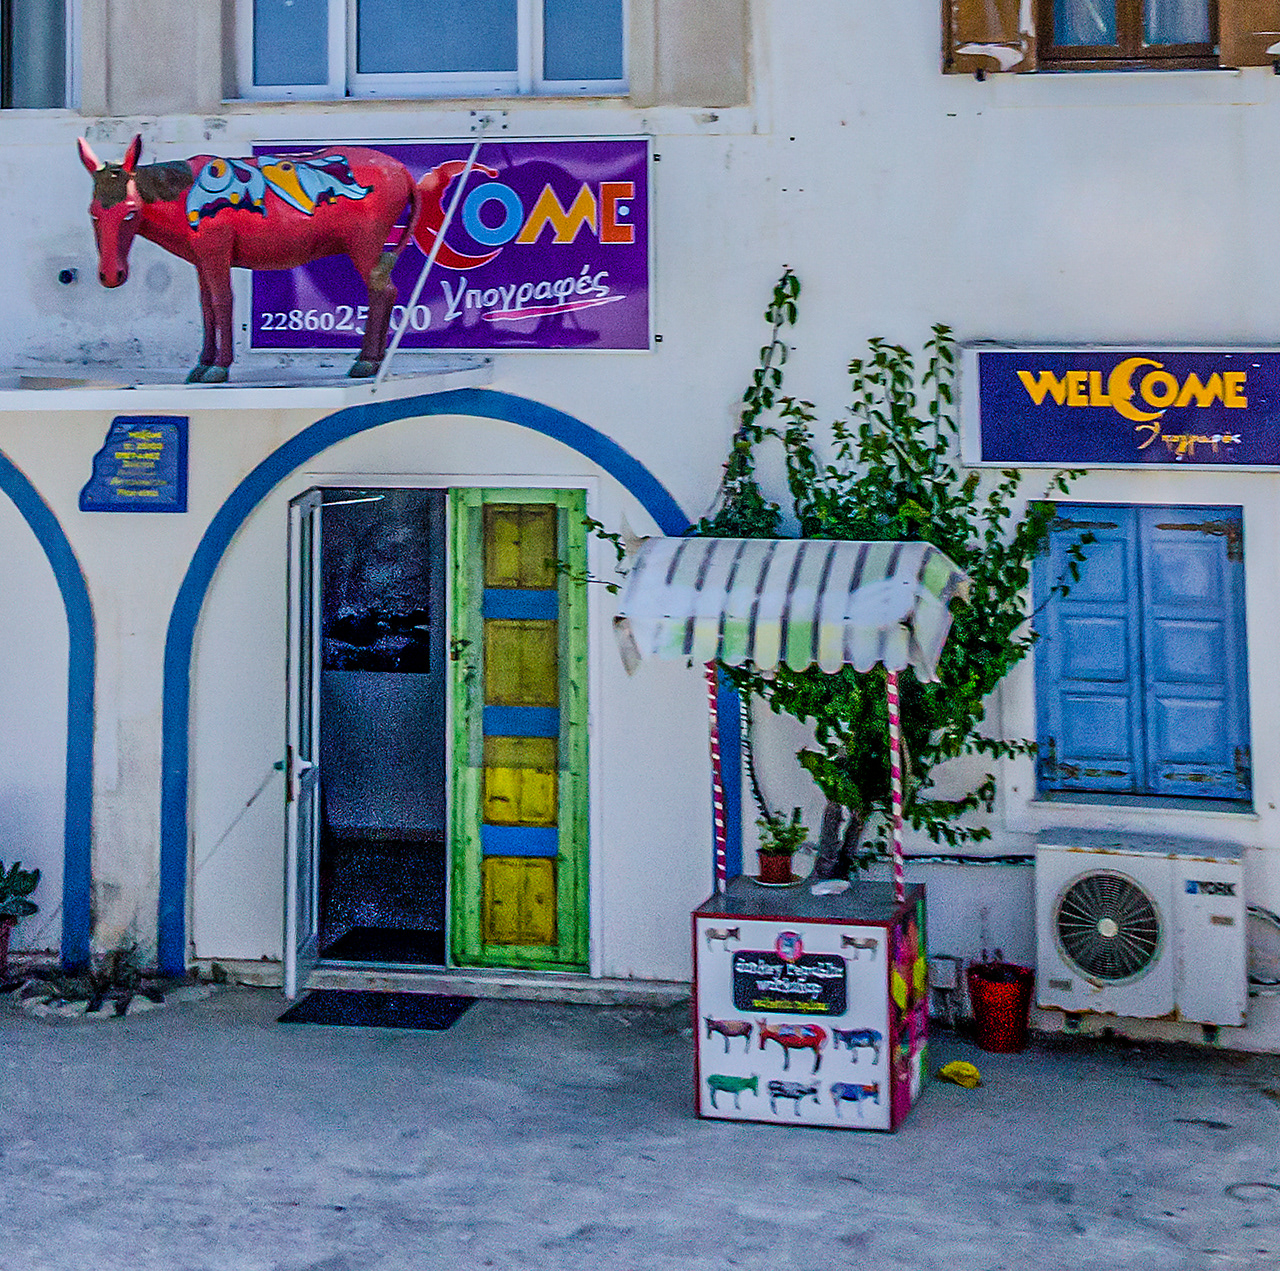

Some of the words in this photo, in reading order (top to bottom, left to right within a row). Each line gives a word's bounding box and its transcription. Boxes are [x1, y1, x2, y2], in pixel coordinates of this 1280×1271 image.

[384, 159, 634, 270] COME
[260, 305, 431, 333] 228602500
[440, 265, 610, 321] Υπογραφές
[1016, 357, 1248, 422] WELCOME
[1198, 881, 1237, 896] YORK
